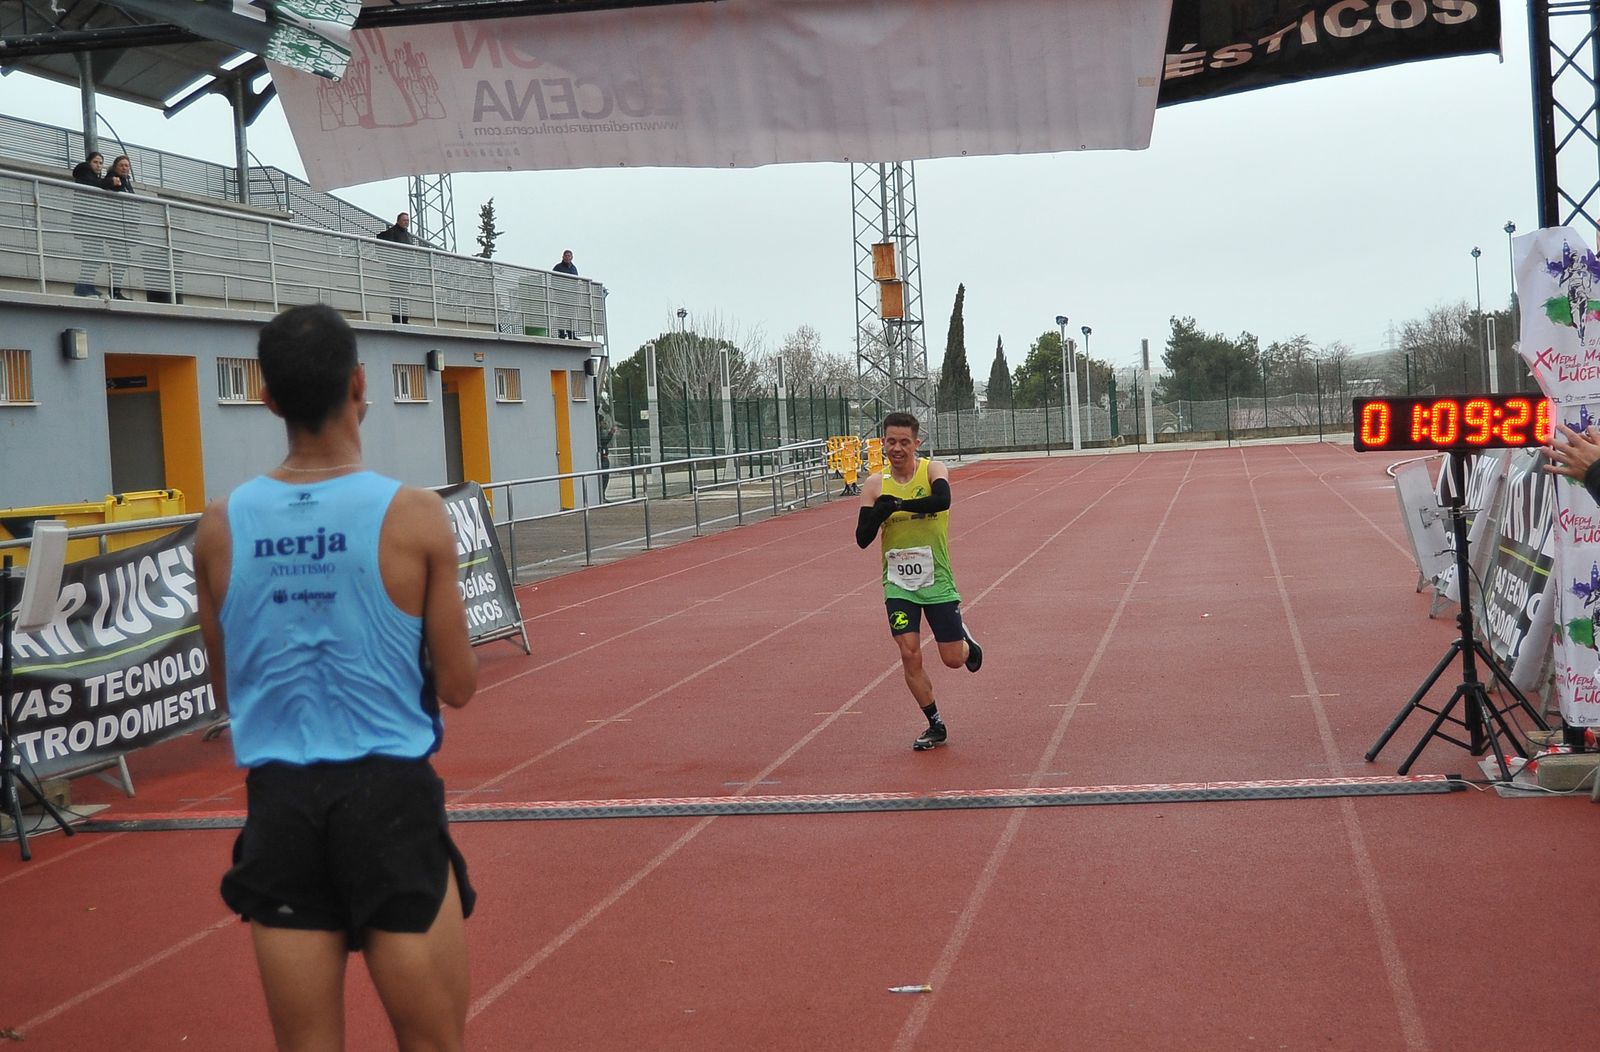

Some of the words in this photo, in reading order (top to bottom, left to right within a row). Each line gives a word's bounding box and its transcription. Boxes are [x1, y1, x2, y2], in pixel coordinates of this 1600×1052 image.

[1362, 402, 1388, 445] 0
[254, 527, 347, 560] nerja
[270, 563, 336, 577] ATLETISMO
[897, 563, 923, 576] 900
[291, 589, 337, 604] cajamar
[85, 648, 209, 707] TECNOLO
[12, 684, 216, 764] TRODOMESTI
